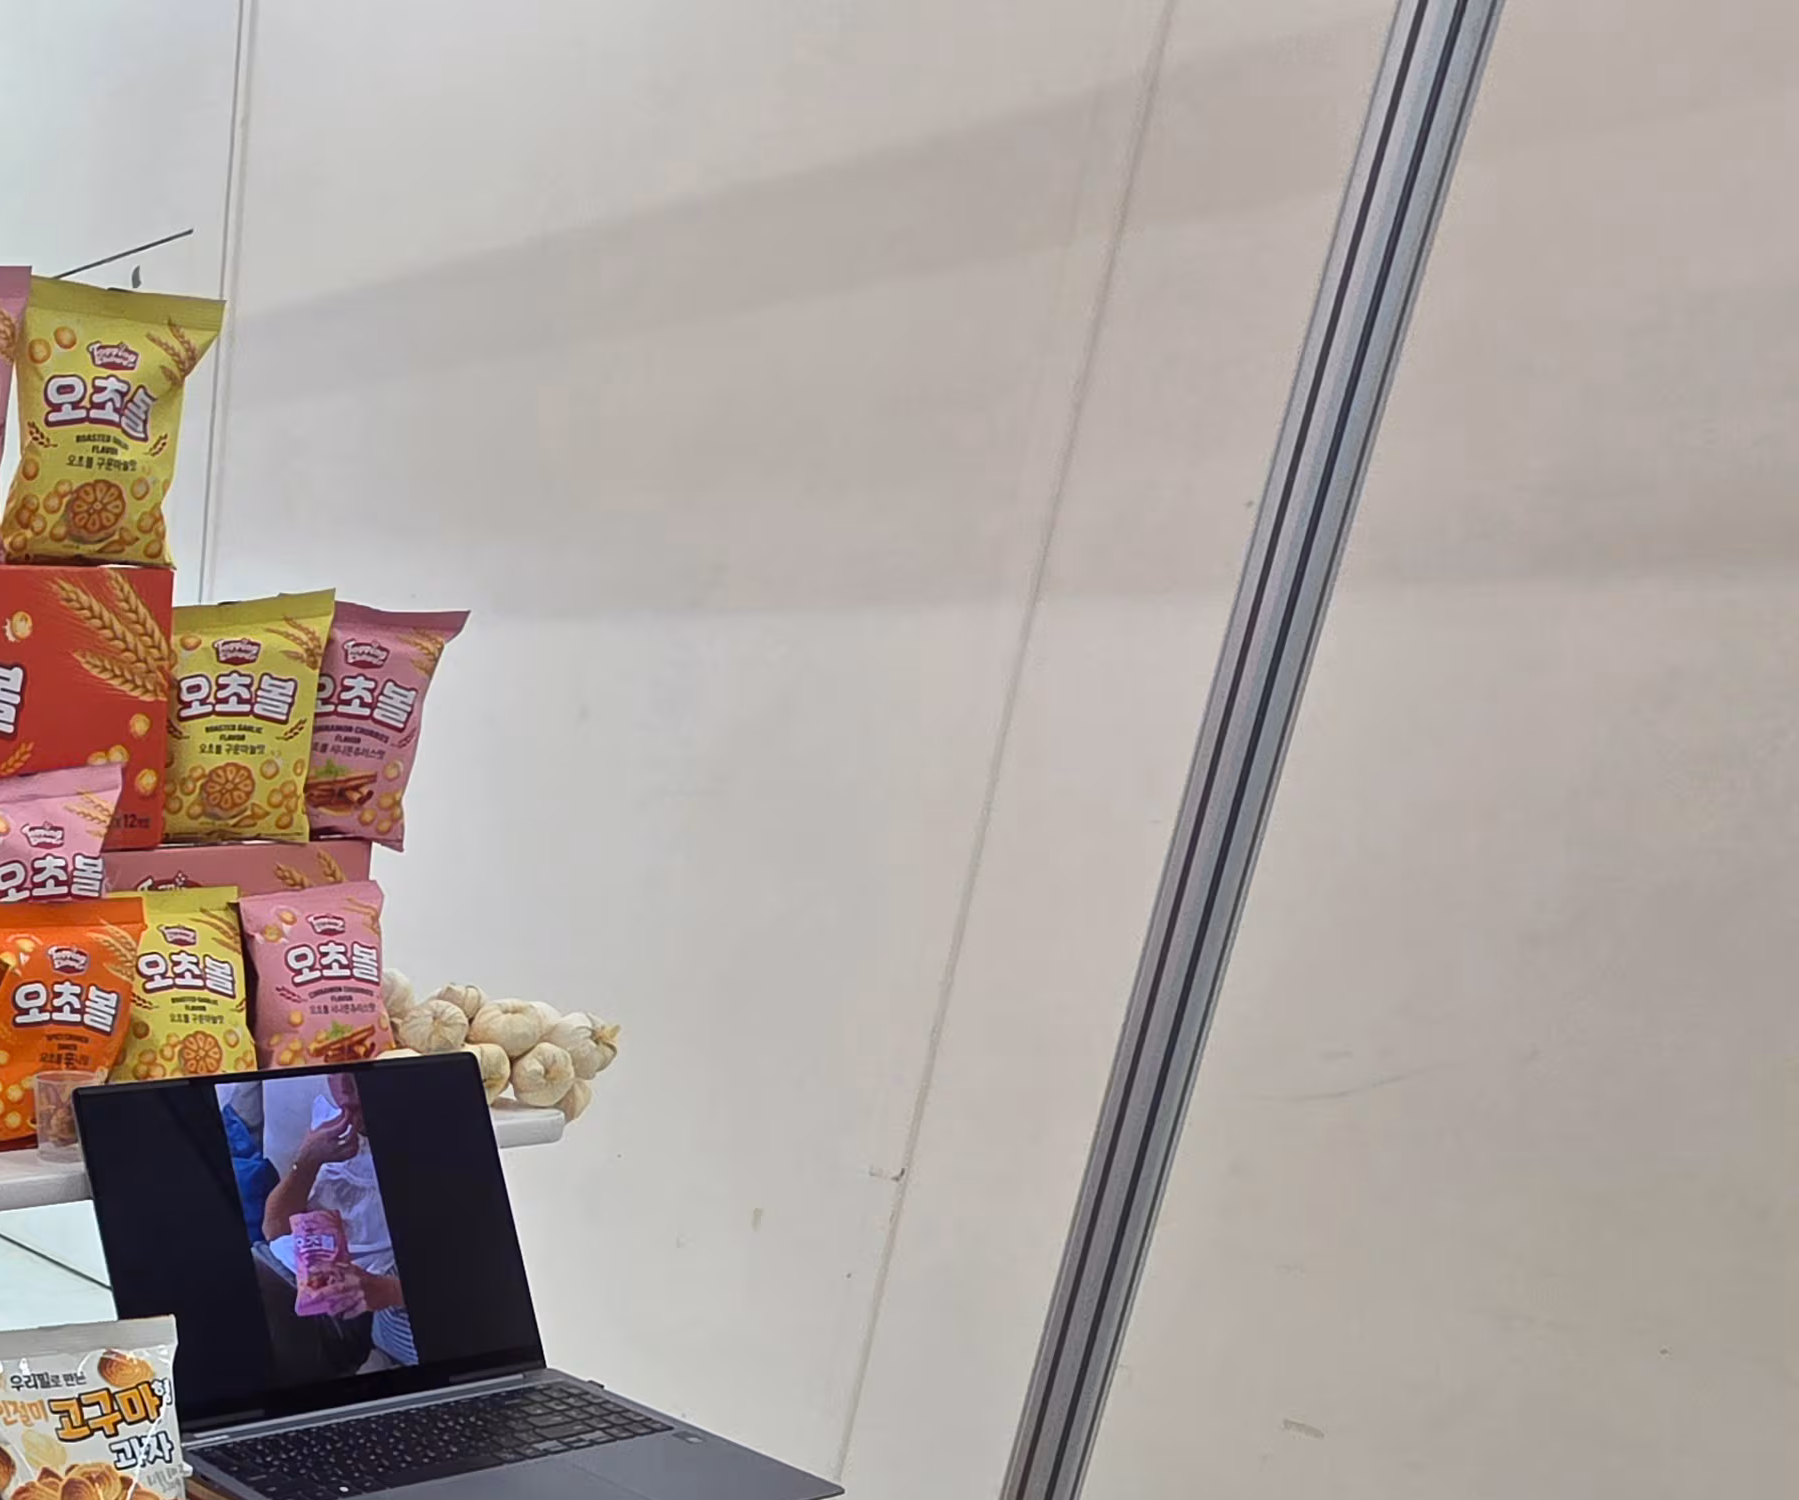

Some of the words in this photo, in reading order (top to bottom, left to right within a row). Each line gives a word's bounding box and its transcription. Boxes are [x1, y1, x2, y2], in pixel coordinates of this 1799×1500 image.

[45, 374, 154, 440] 오초볼
[179, 671, 297, 721] 오초볼
[315, 674, 418, 728] 오초볼
[137, 951, 236, 996] 오초볼
[286, 941, 380, 984] 오초볼
[14, 981, 118, 1033] 오초볼
[109, 1431, 174, 1471] 과자
